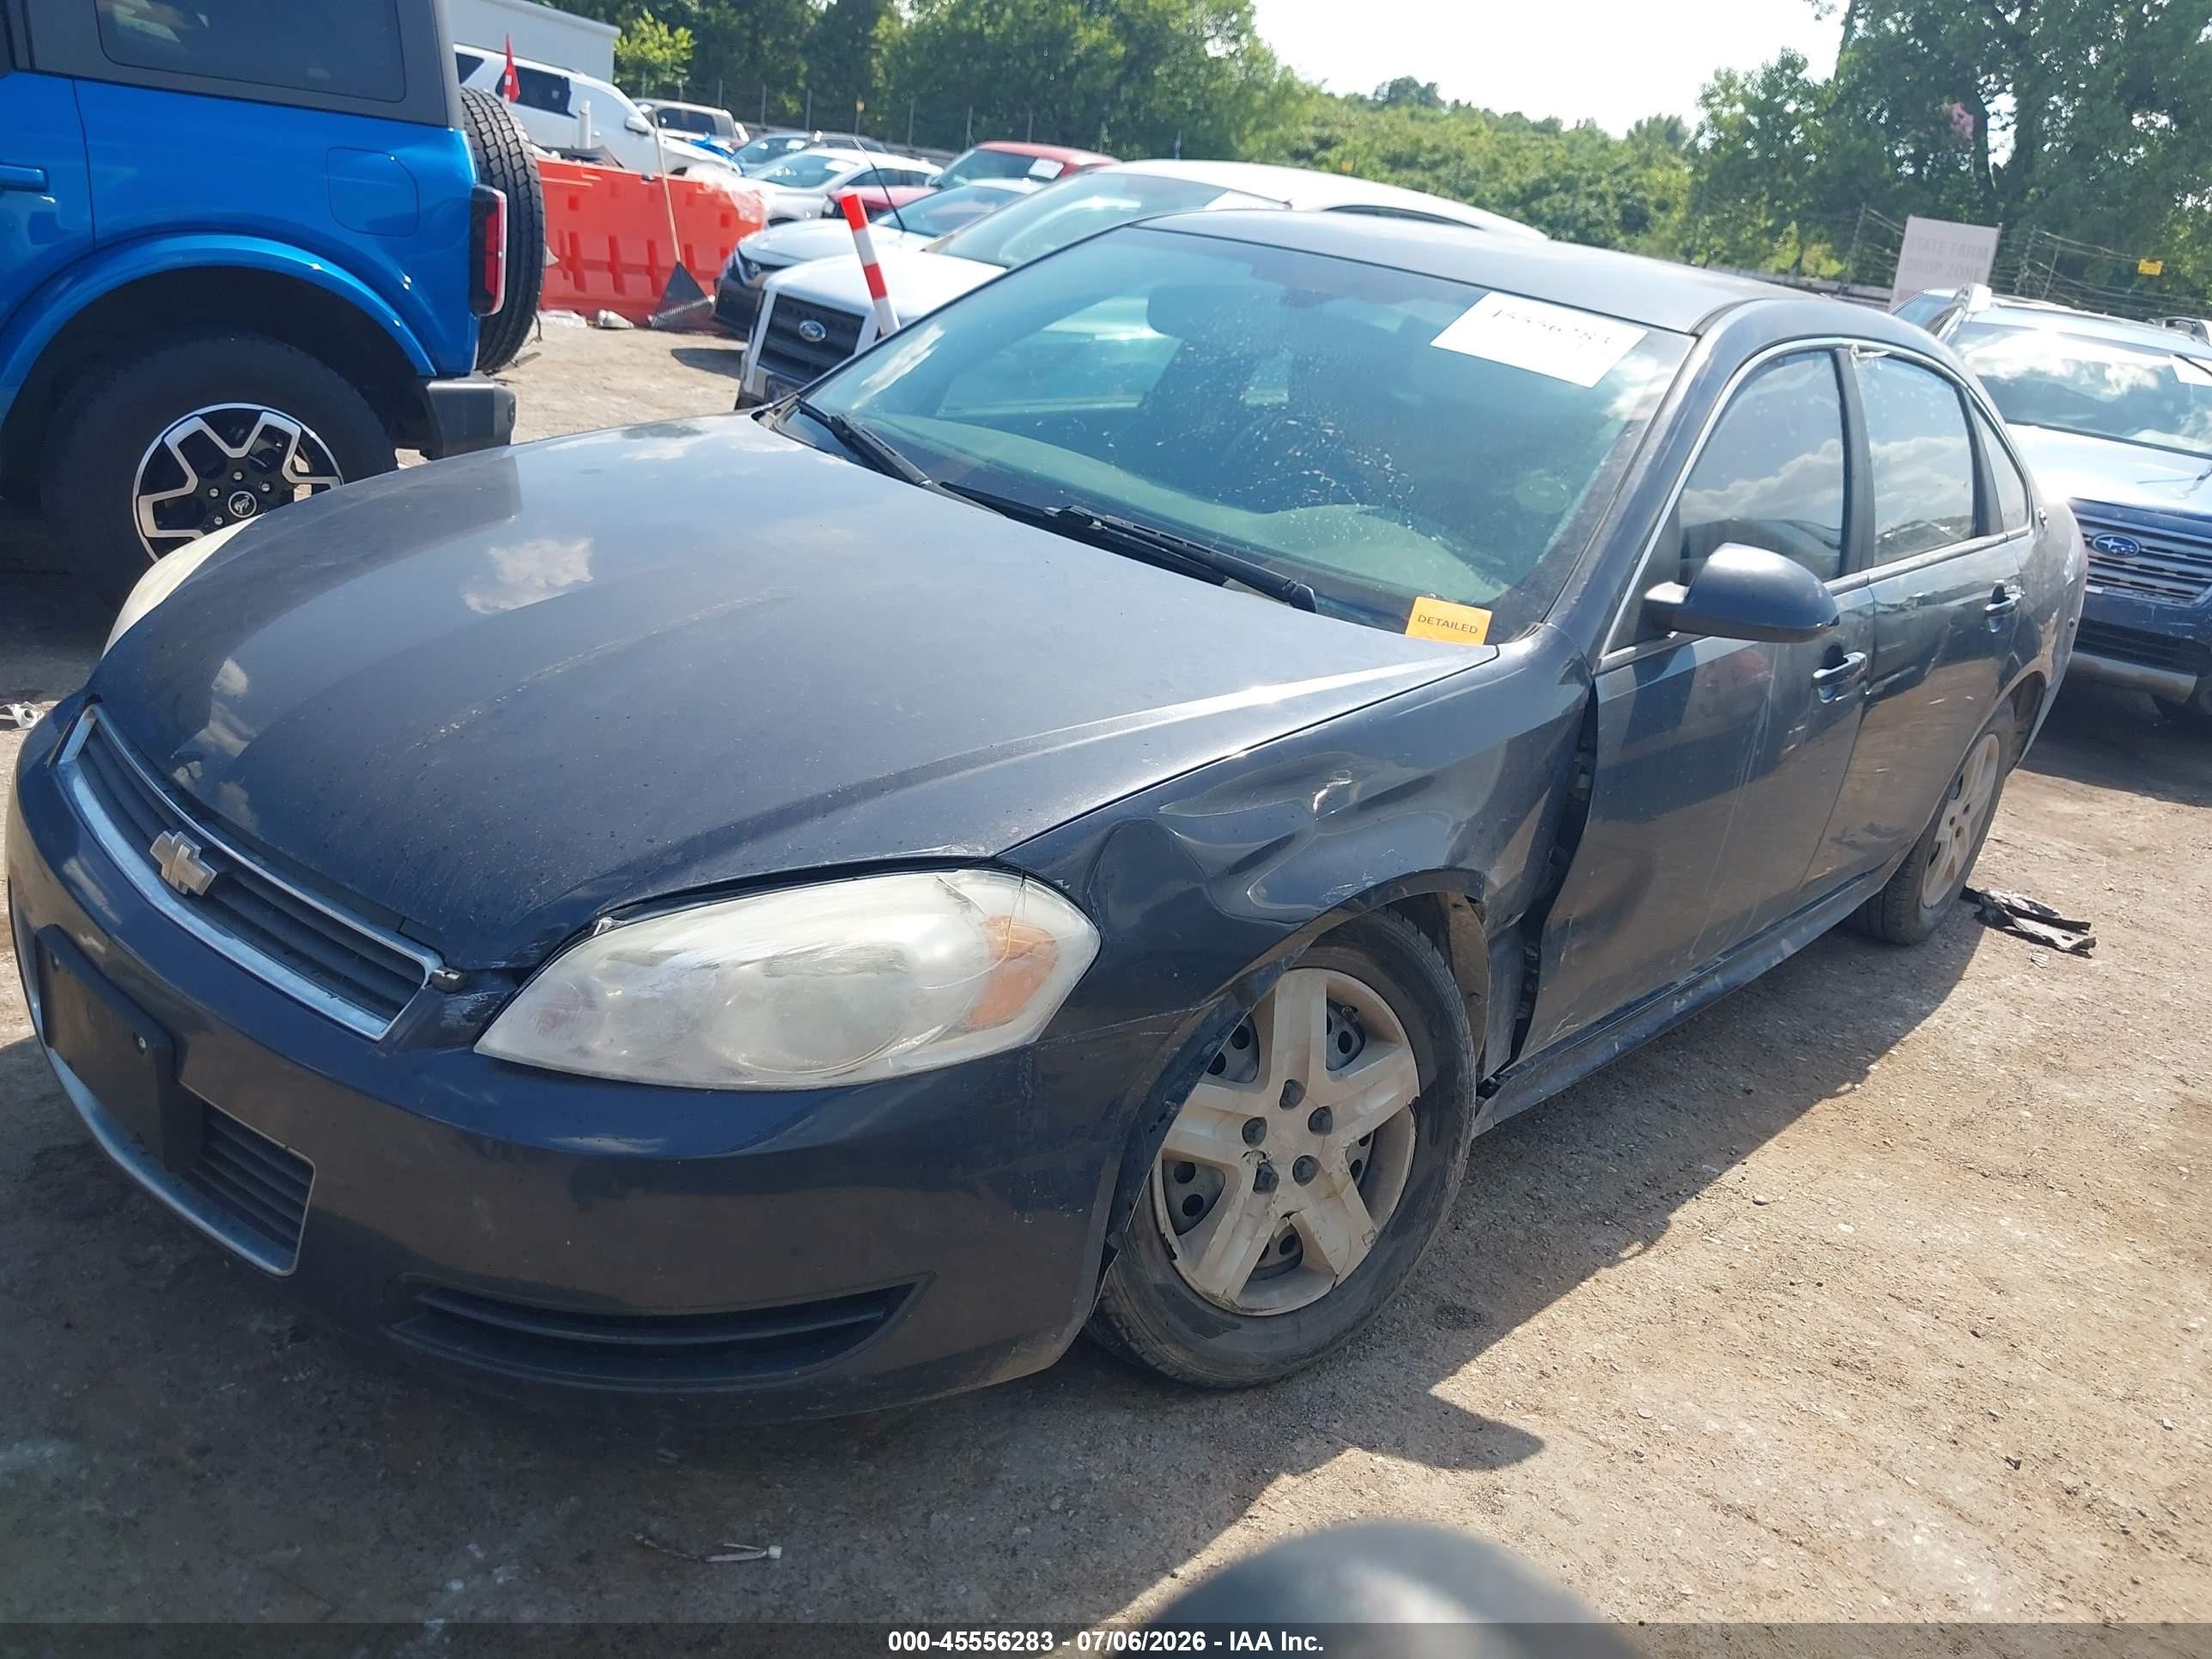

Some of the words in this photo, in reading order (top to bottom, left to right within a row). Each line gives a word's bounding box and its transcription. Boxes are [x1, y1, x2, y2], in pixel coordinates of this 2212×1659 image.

[1906, 235, 1947, 255] STATE
[1949, 240, 1990, 261] FARM
[1903, 257, 1943, 275] DROP
[1945, 263, 1984, 283] ZONE
[1418, 615, 1478, 634] DETAILED
